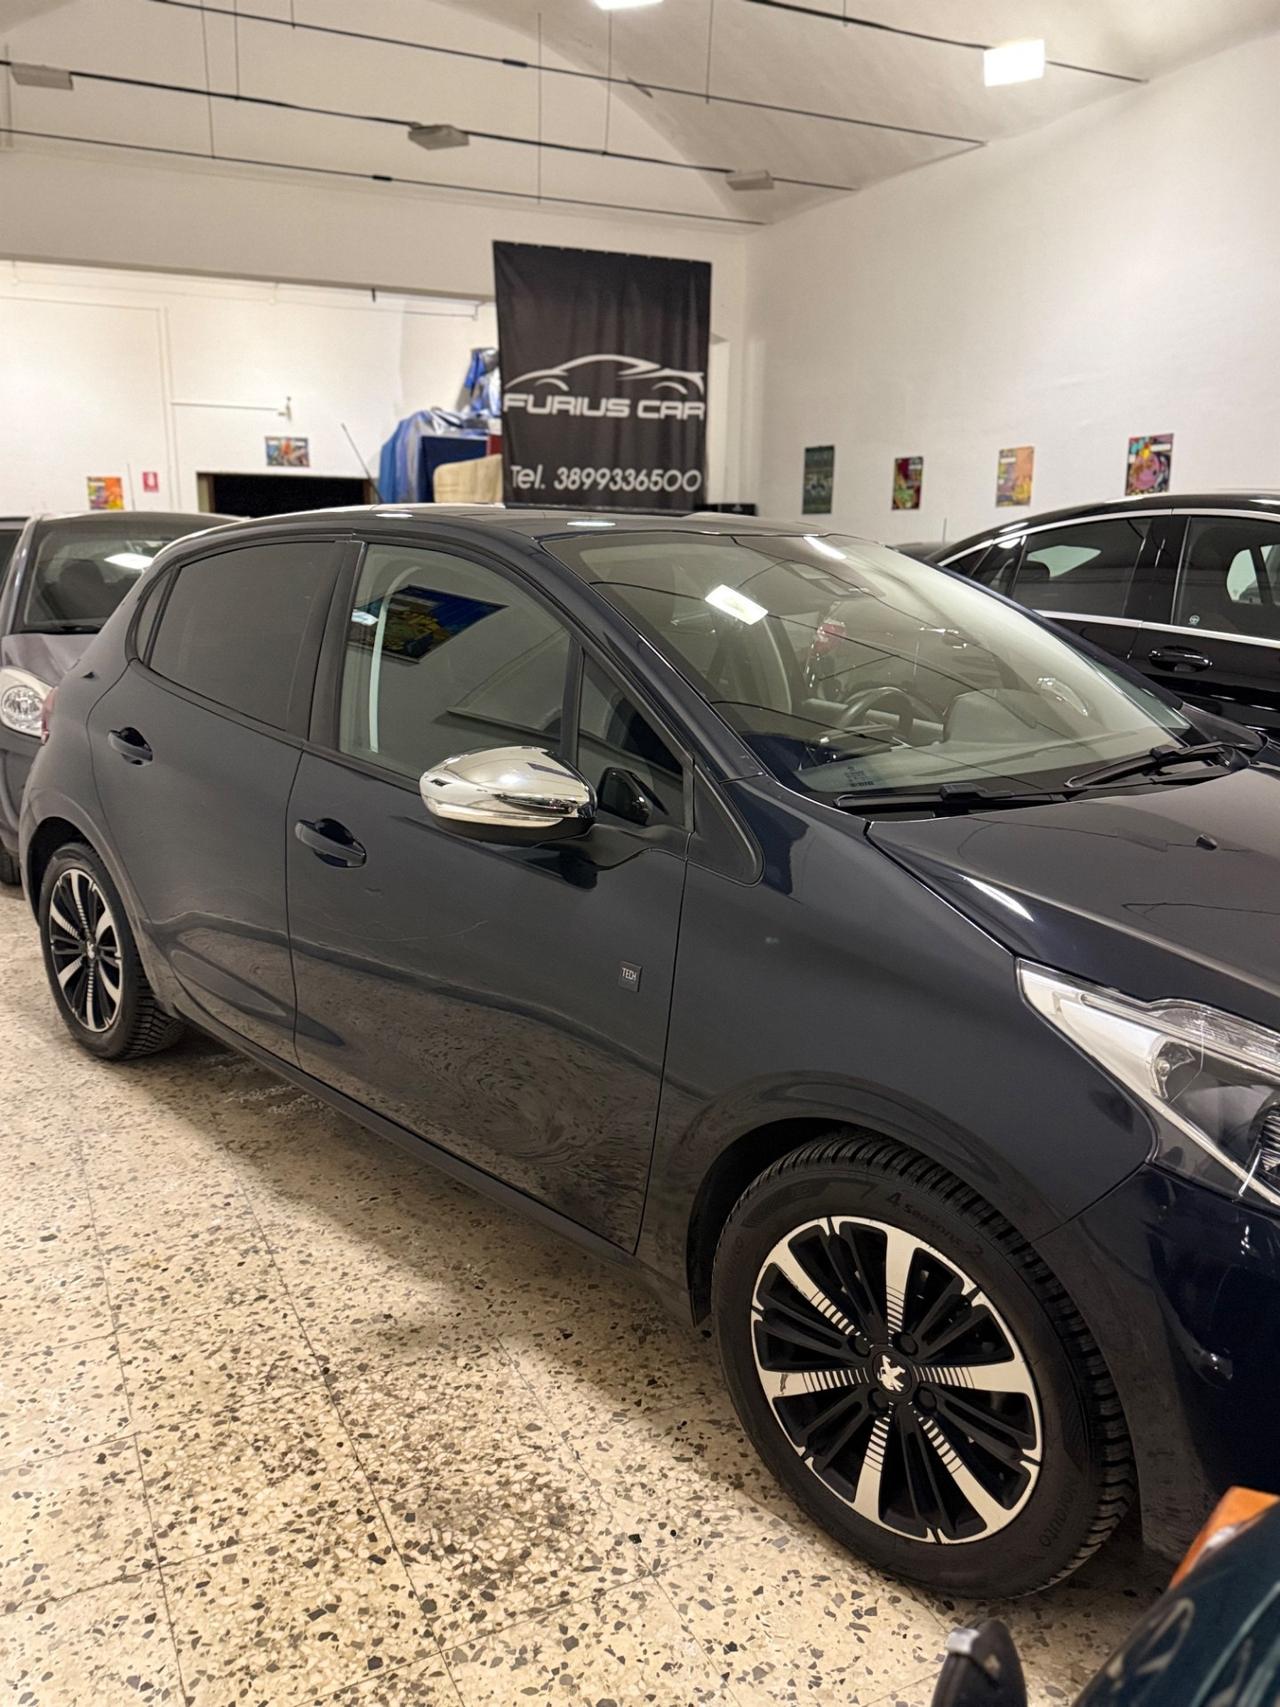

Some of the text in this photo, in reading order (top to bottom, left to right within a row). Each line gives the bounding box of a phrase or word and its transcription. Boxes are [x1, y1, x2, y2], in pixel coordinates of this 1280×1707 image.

[503, 393, 705, 421] FURIUS CAR
[511, 465, 702, 492] Tel. 3899336500
[885, 1191, 902, 1207] 4
